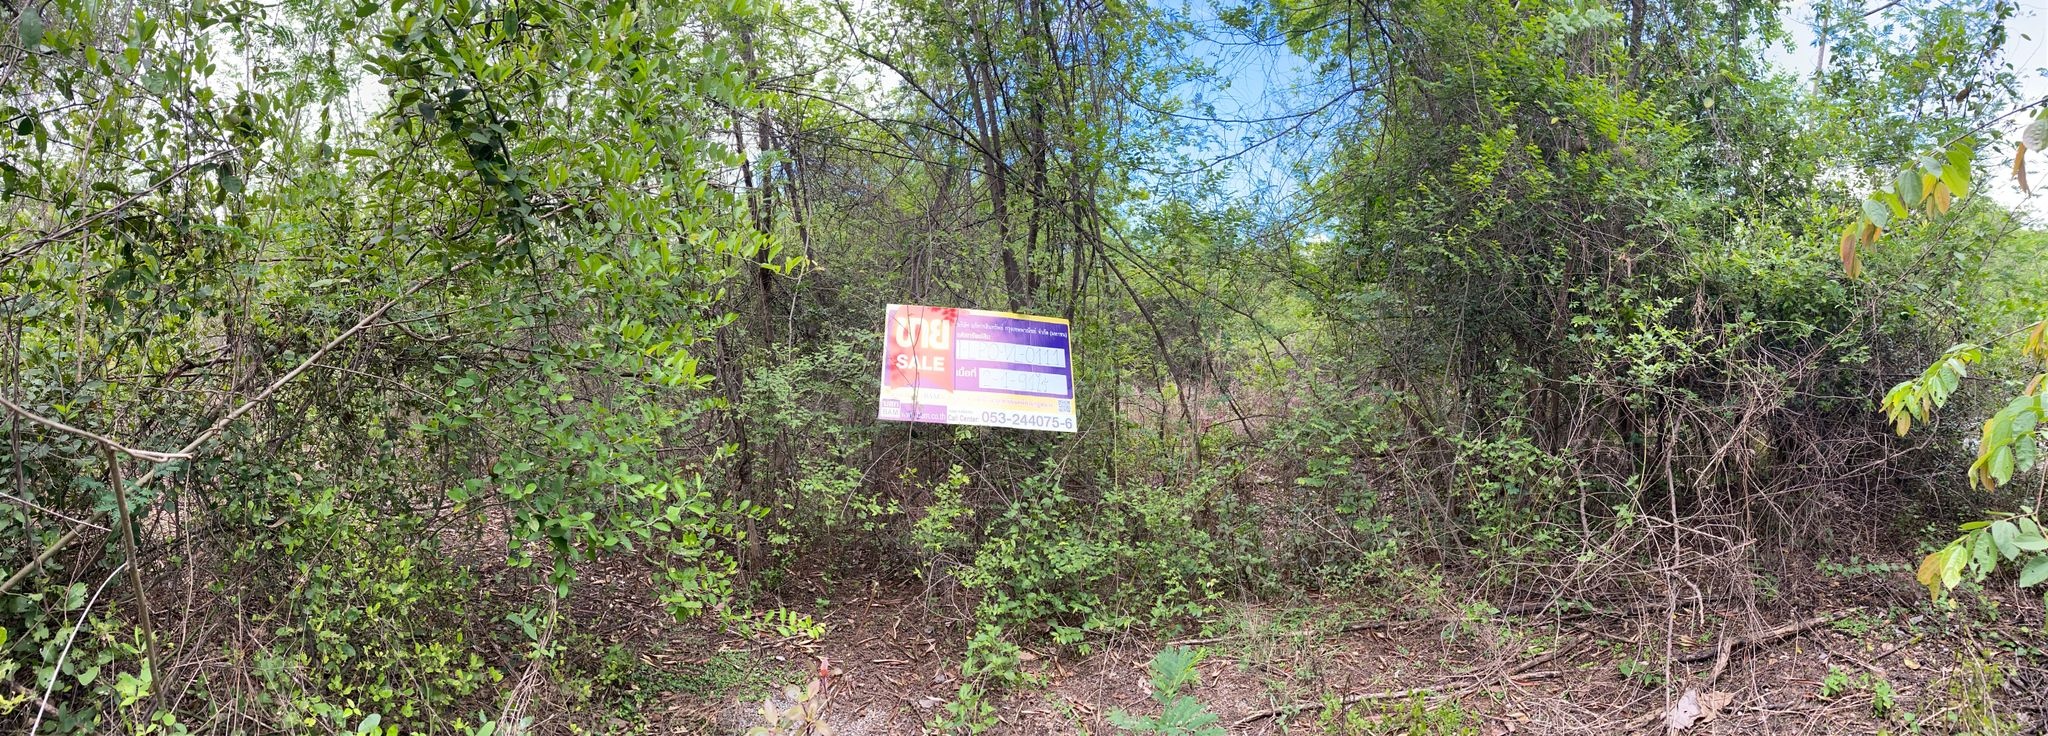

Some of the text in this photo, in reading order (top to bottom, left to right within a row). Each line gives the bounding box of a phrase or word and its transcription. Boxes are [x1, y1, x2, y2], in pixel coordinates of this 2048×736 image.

[896, 317, 950, 349] ขาย
[896, 354, 945, 371] SALE
[981, 411, 1073, 429] 053-244075-6
